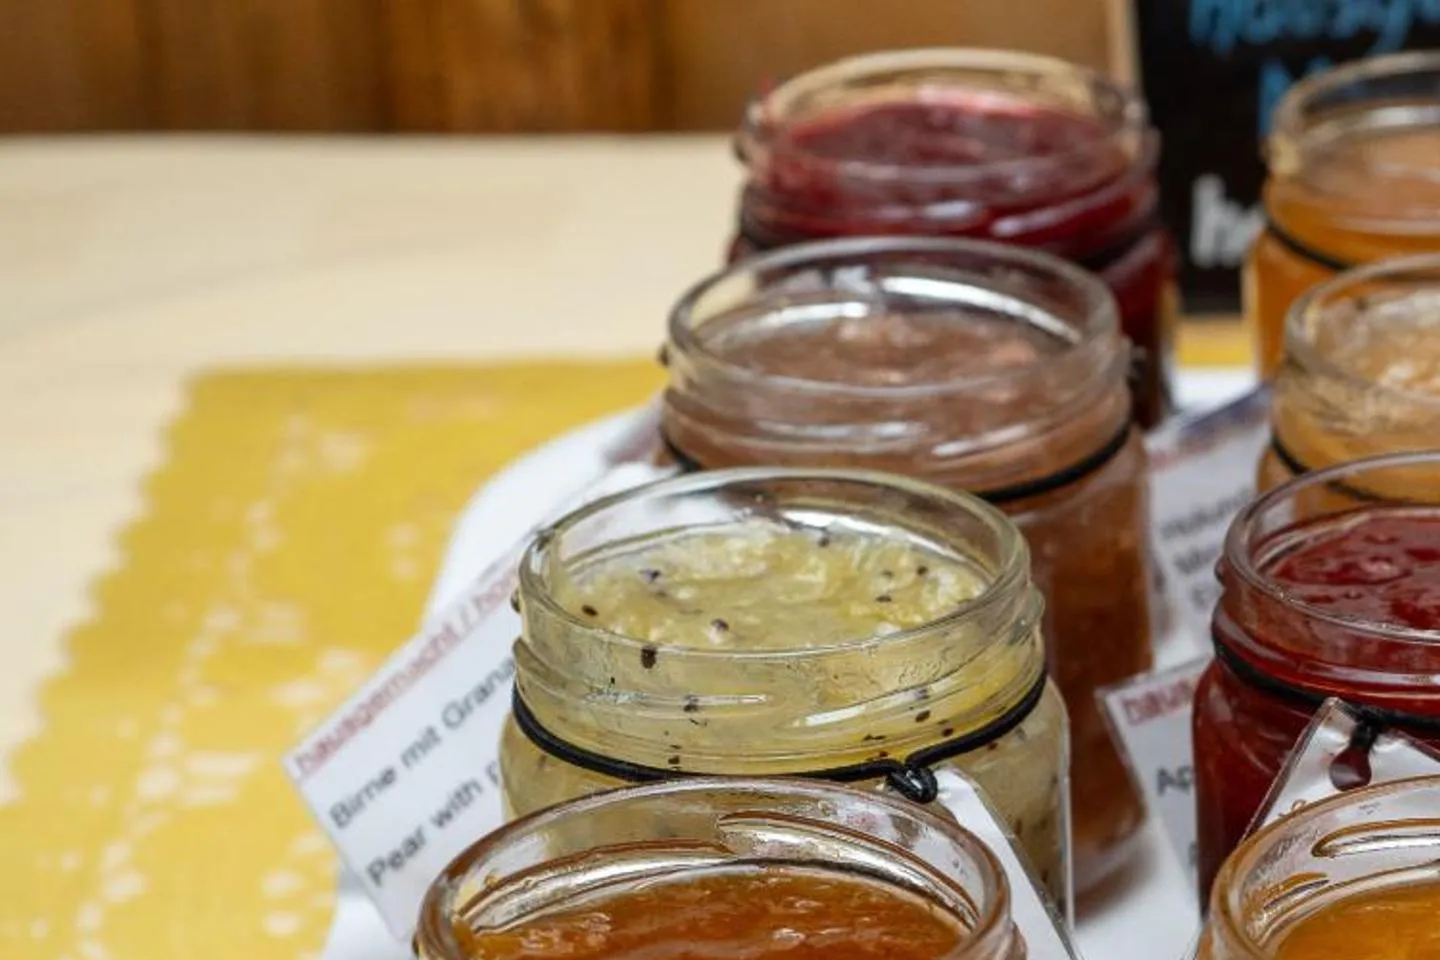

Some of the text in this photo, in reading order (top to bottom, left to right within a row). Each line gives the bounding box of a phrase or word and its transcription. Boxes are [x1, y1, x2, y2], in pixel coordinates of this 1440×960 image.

[330, 764, 397, 830] Birne
[401, 724, 445, 774] mit
[442, 655, 516, 731] Grana
[365, 778, 484, 890] Pear with
